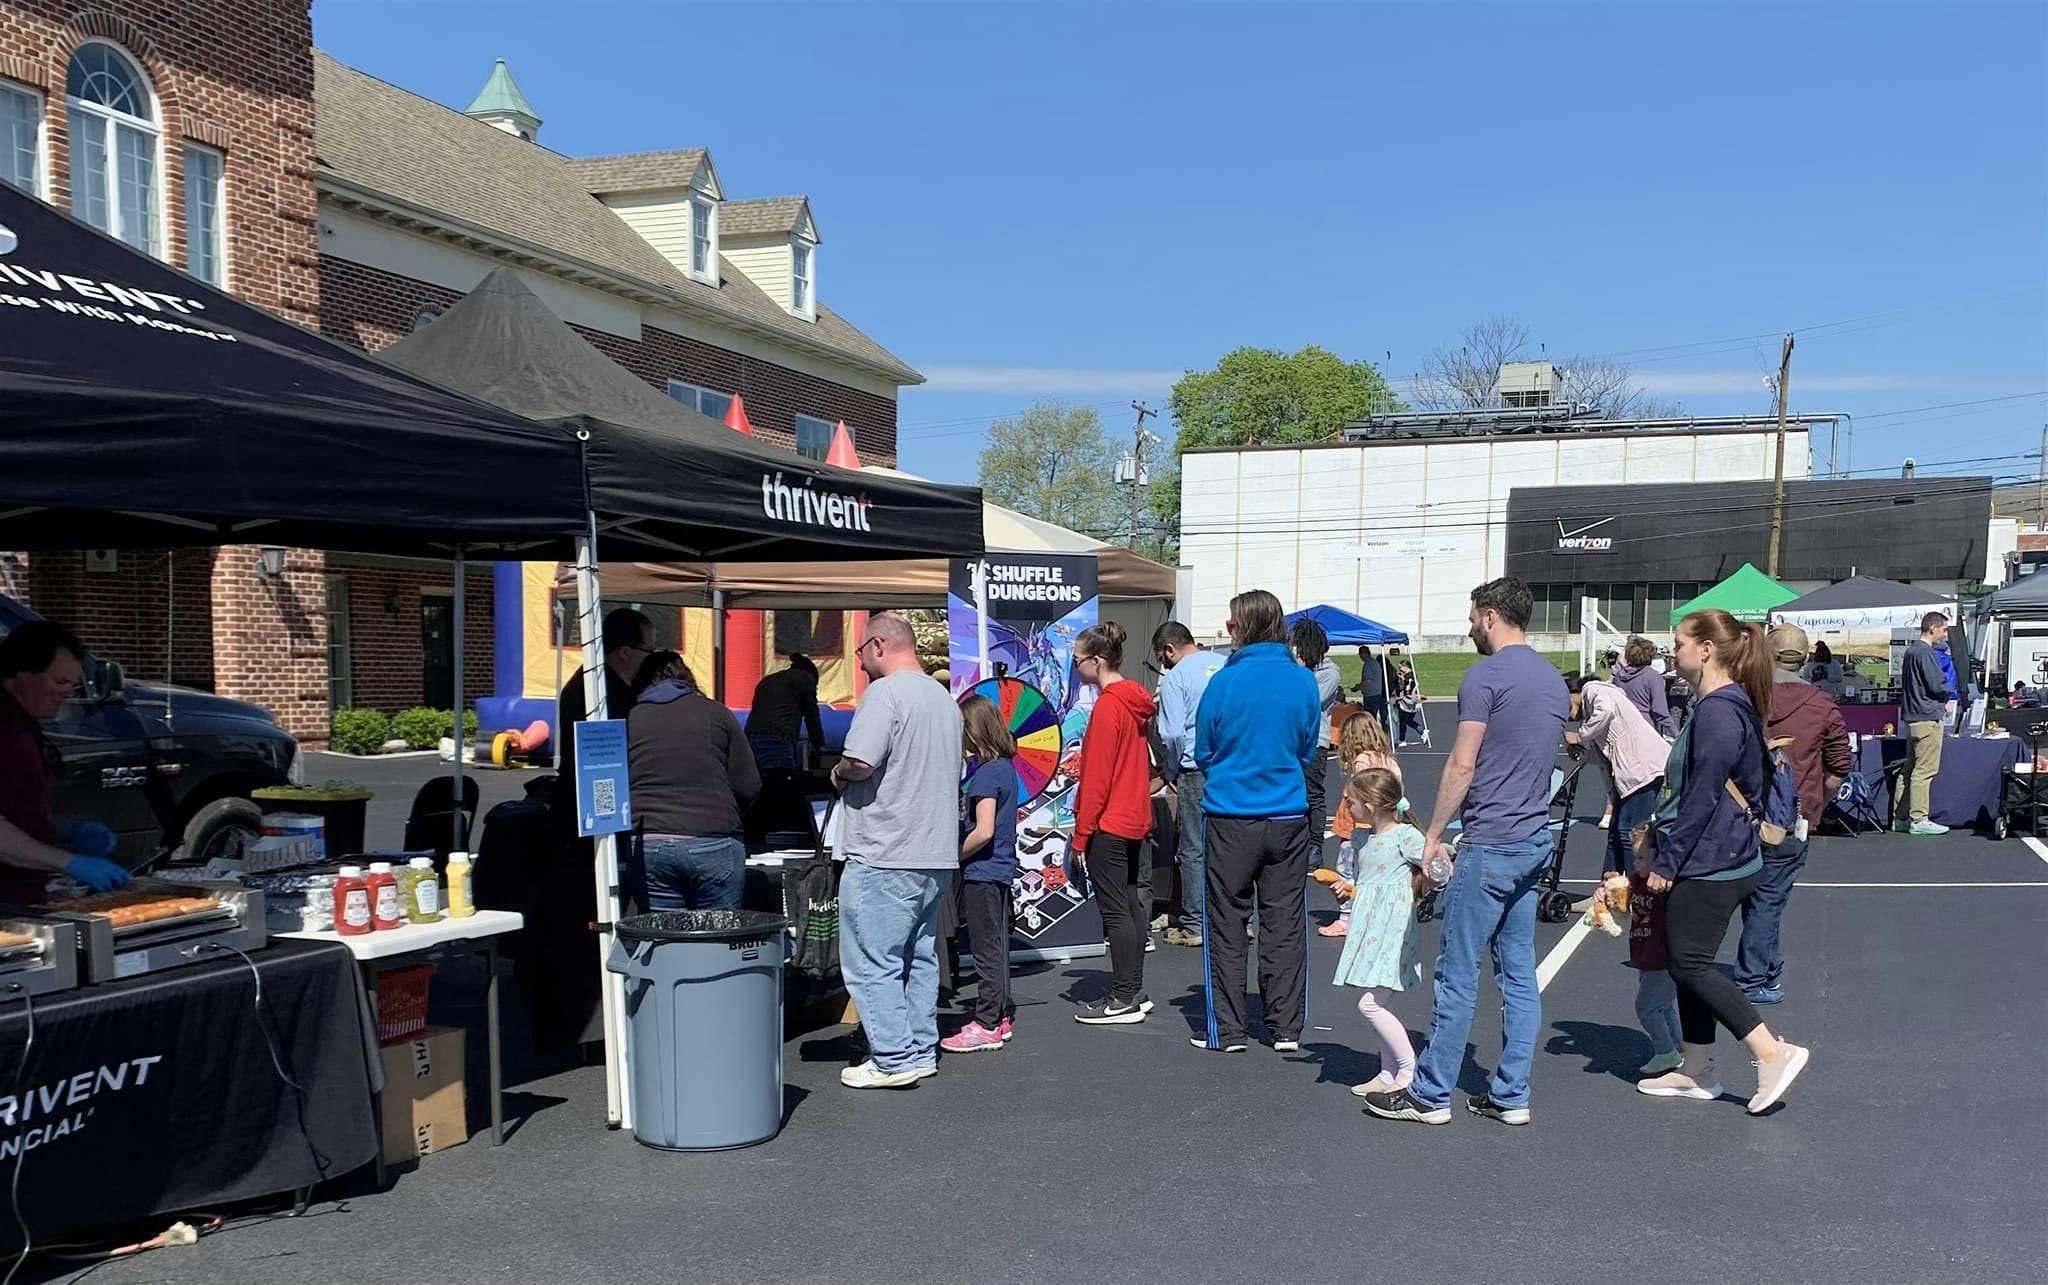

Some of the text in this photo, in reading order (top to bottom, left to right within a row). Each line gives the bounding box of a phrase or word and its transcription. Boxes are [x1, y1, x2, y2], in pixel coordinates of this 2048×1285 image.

[0, 263, 191, 313] IVENT
[40, 298, 125, 322] With
[761, 471, 871, 532] thrivent
[1558, 535, 1612, 550] verizon
[992, 565, 1063, 583] SHUFFLE
[988, 583, 1082, 602] DUNGEONS
